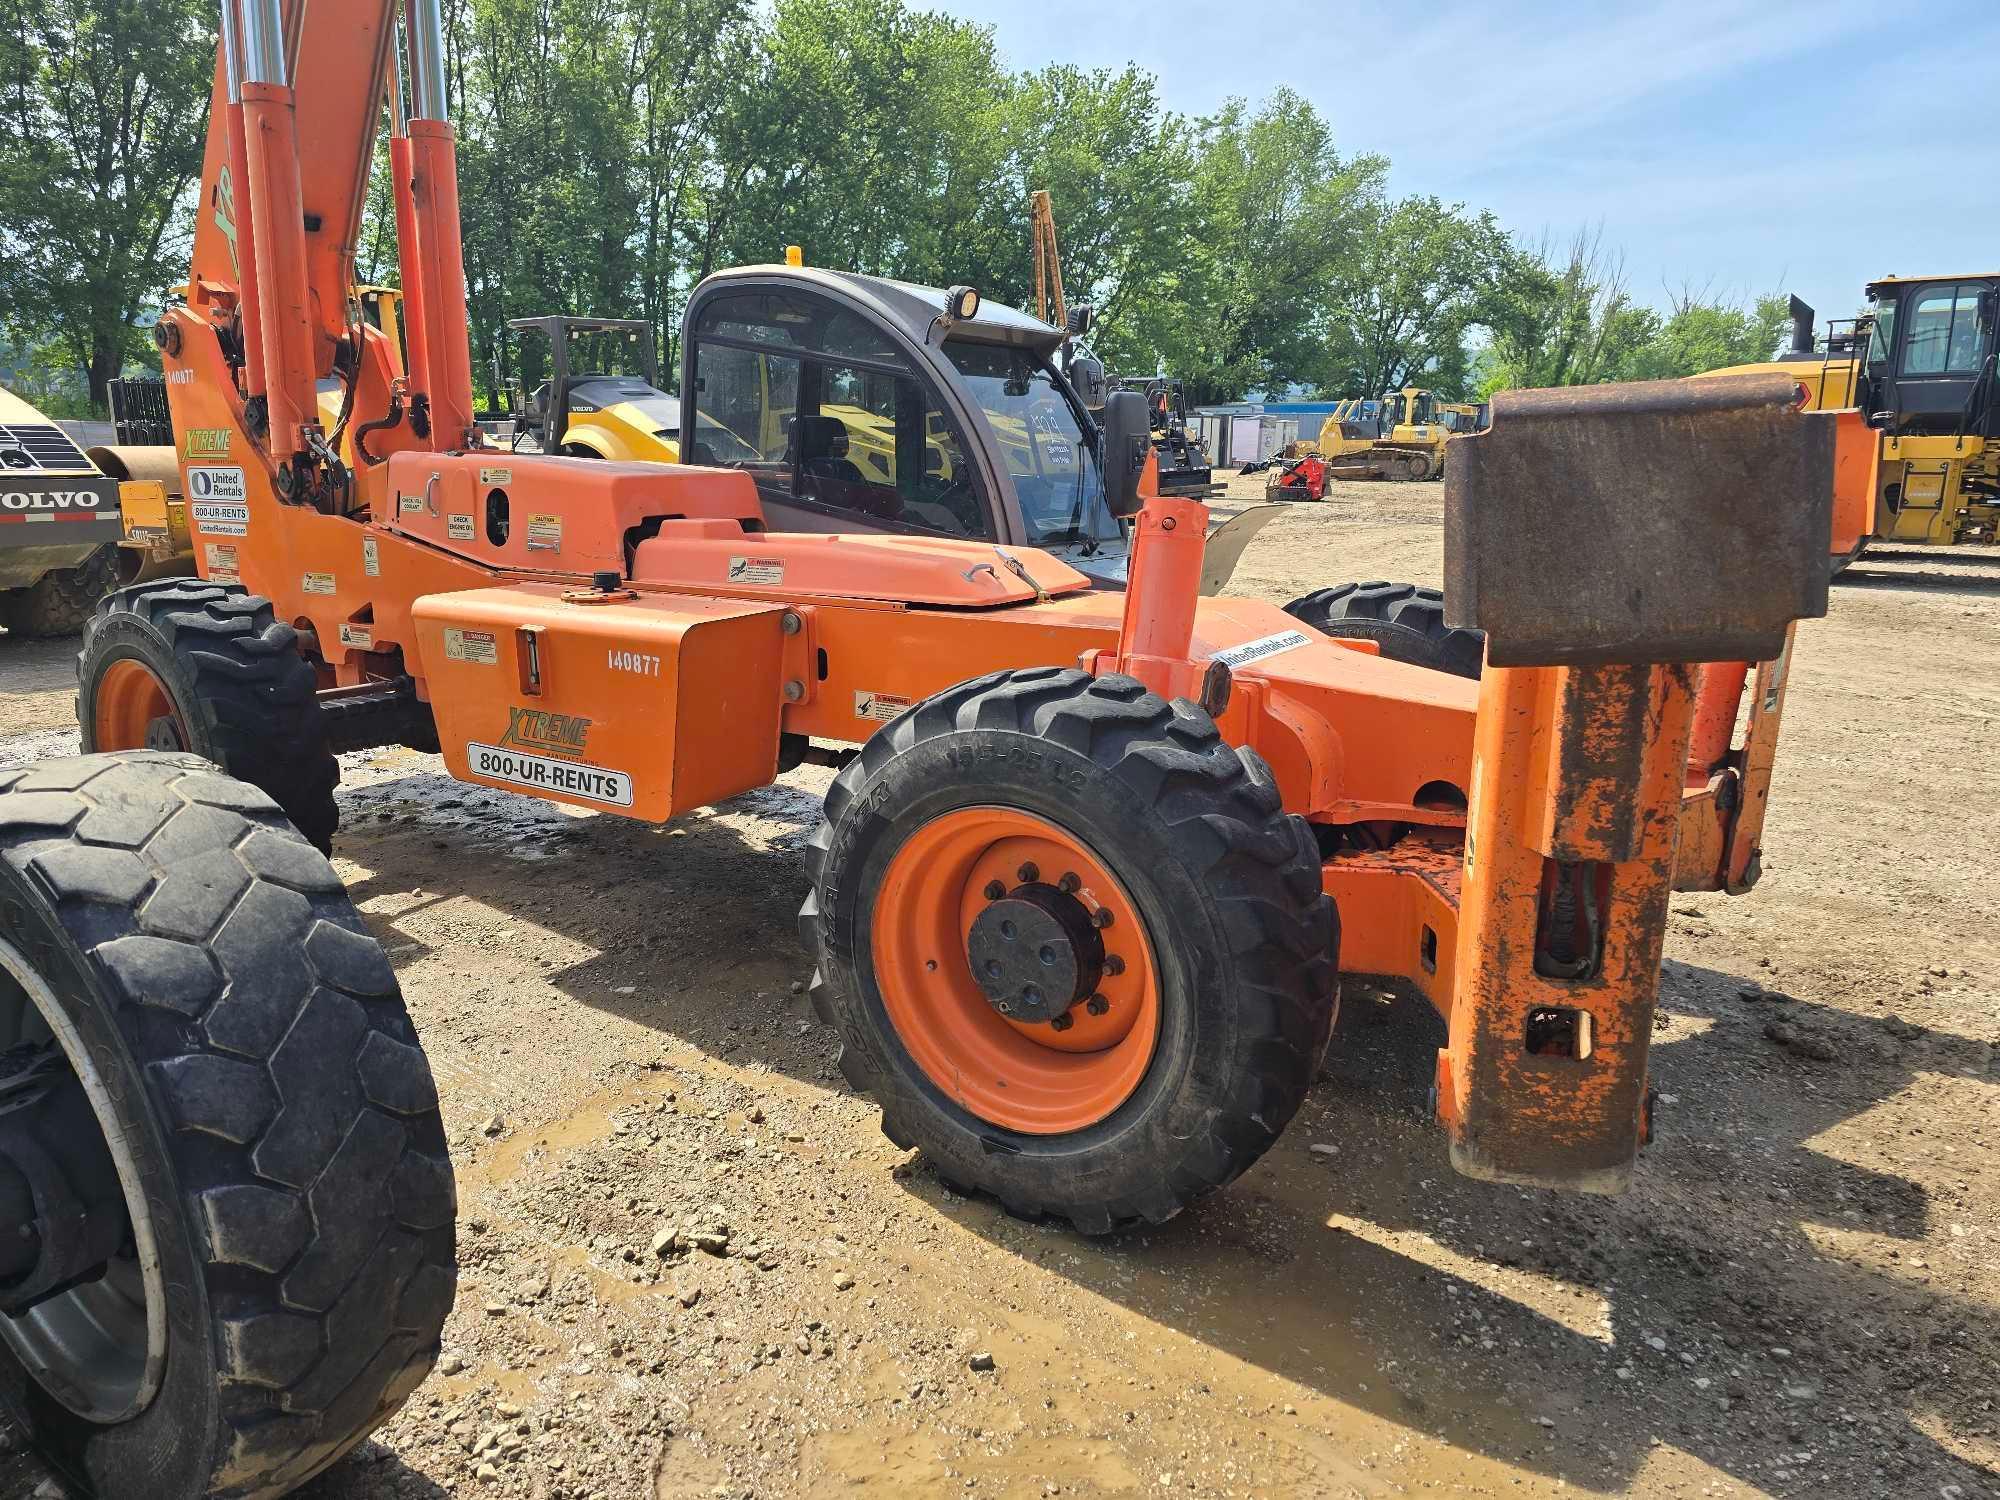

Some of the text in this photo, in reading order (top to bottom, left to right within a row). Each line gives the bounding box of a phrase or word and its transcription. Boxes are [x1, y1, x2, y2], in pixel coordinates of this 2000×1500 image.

[167, 369, 194, 384] 140877
[181, 427, 233, 463] XTREME
[212, 472, 239, 485] United
[213, 484, 243, 497] Rentals
[0, 492, 99, 509] OLVO
[195, 507, 246, 519] 800-UR-RENTS
[200, 524, 246, 535] UnitedRentals.com
[449, 523, 465, 531] ENGINE
[470, 633, 491, 641] DANGER
[608, 649, 660, 677] 140877
[882, 696, 908, 705] WARNING
[499, 704, 593, 749] XTREME
[546, 751, 600, 767] MANUFACTURING
[480, 752, 618, 798] 800-UR-RENTS
